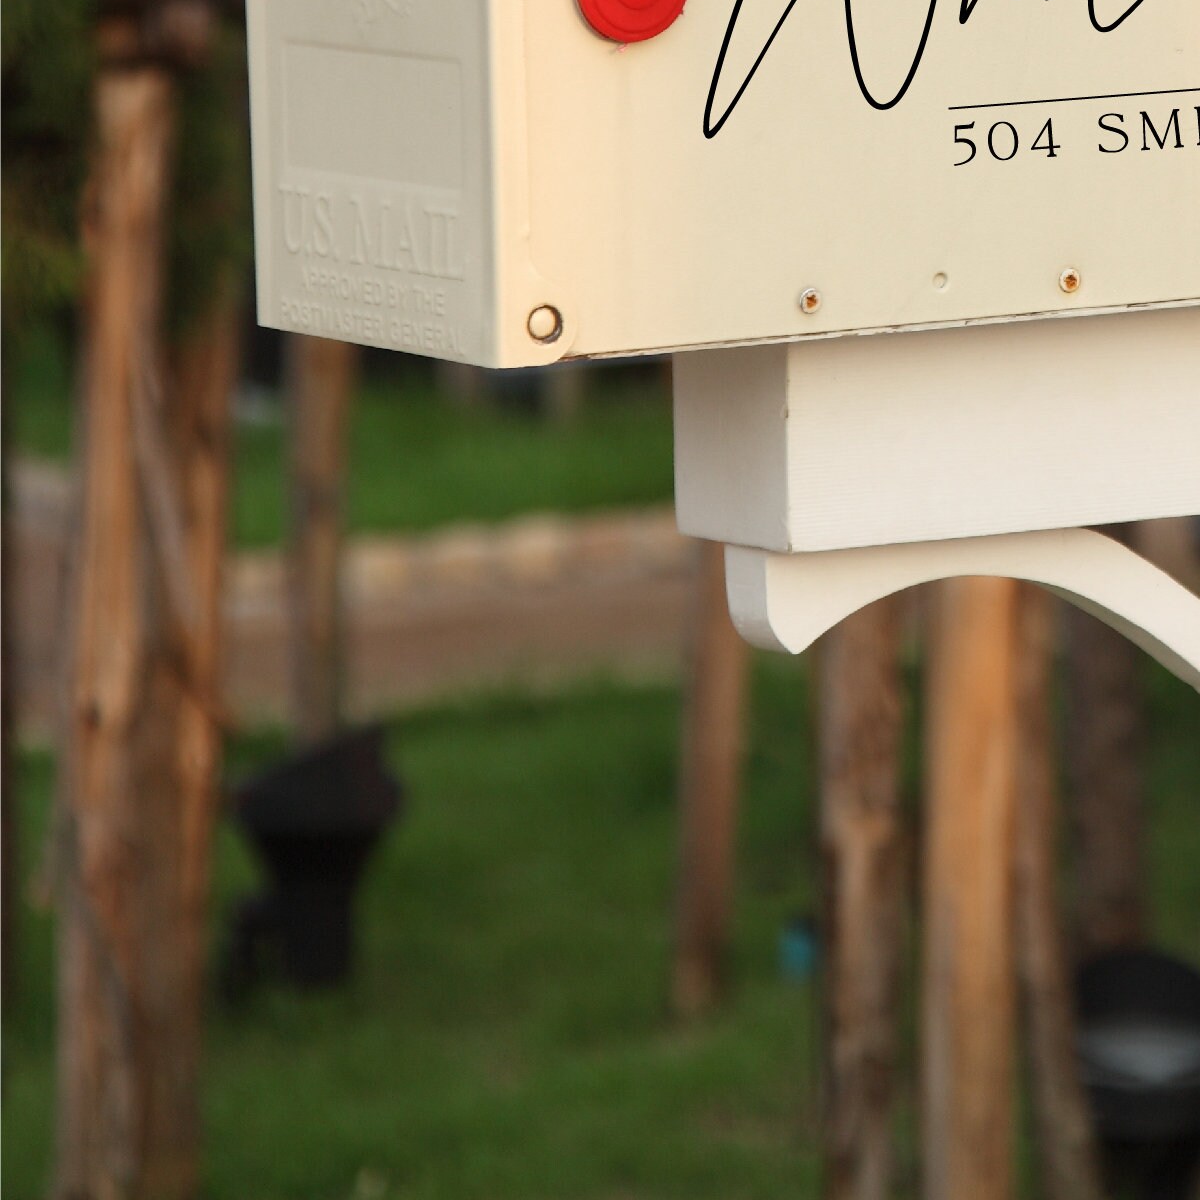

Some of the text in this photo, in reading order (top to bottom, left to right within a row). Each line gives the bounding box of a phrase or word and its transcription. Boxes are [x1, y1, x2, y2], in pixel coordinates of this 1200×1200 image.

[953, 118, 1061, 166] 504
[349, 193, 465, 283] MAIL
[300, 266, 382, 307] APPROVED
[410, 286, 447, 318] THE
[279, 297, 466, 356] POSTMASTER GENERAL
